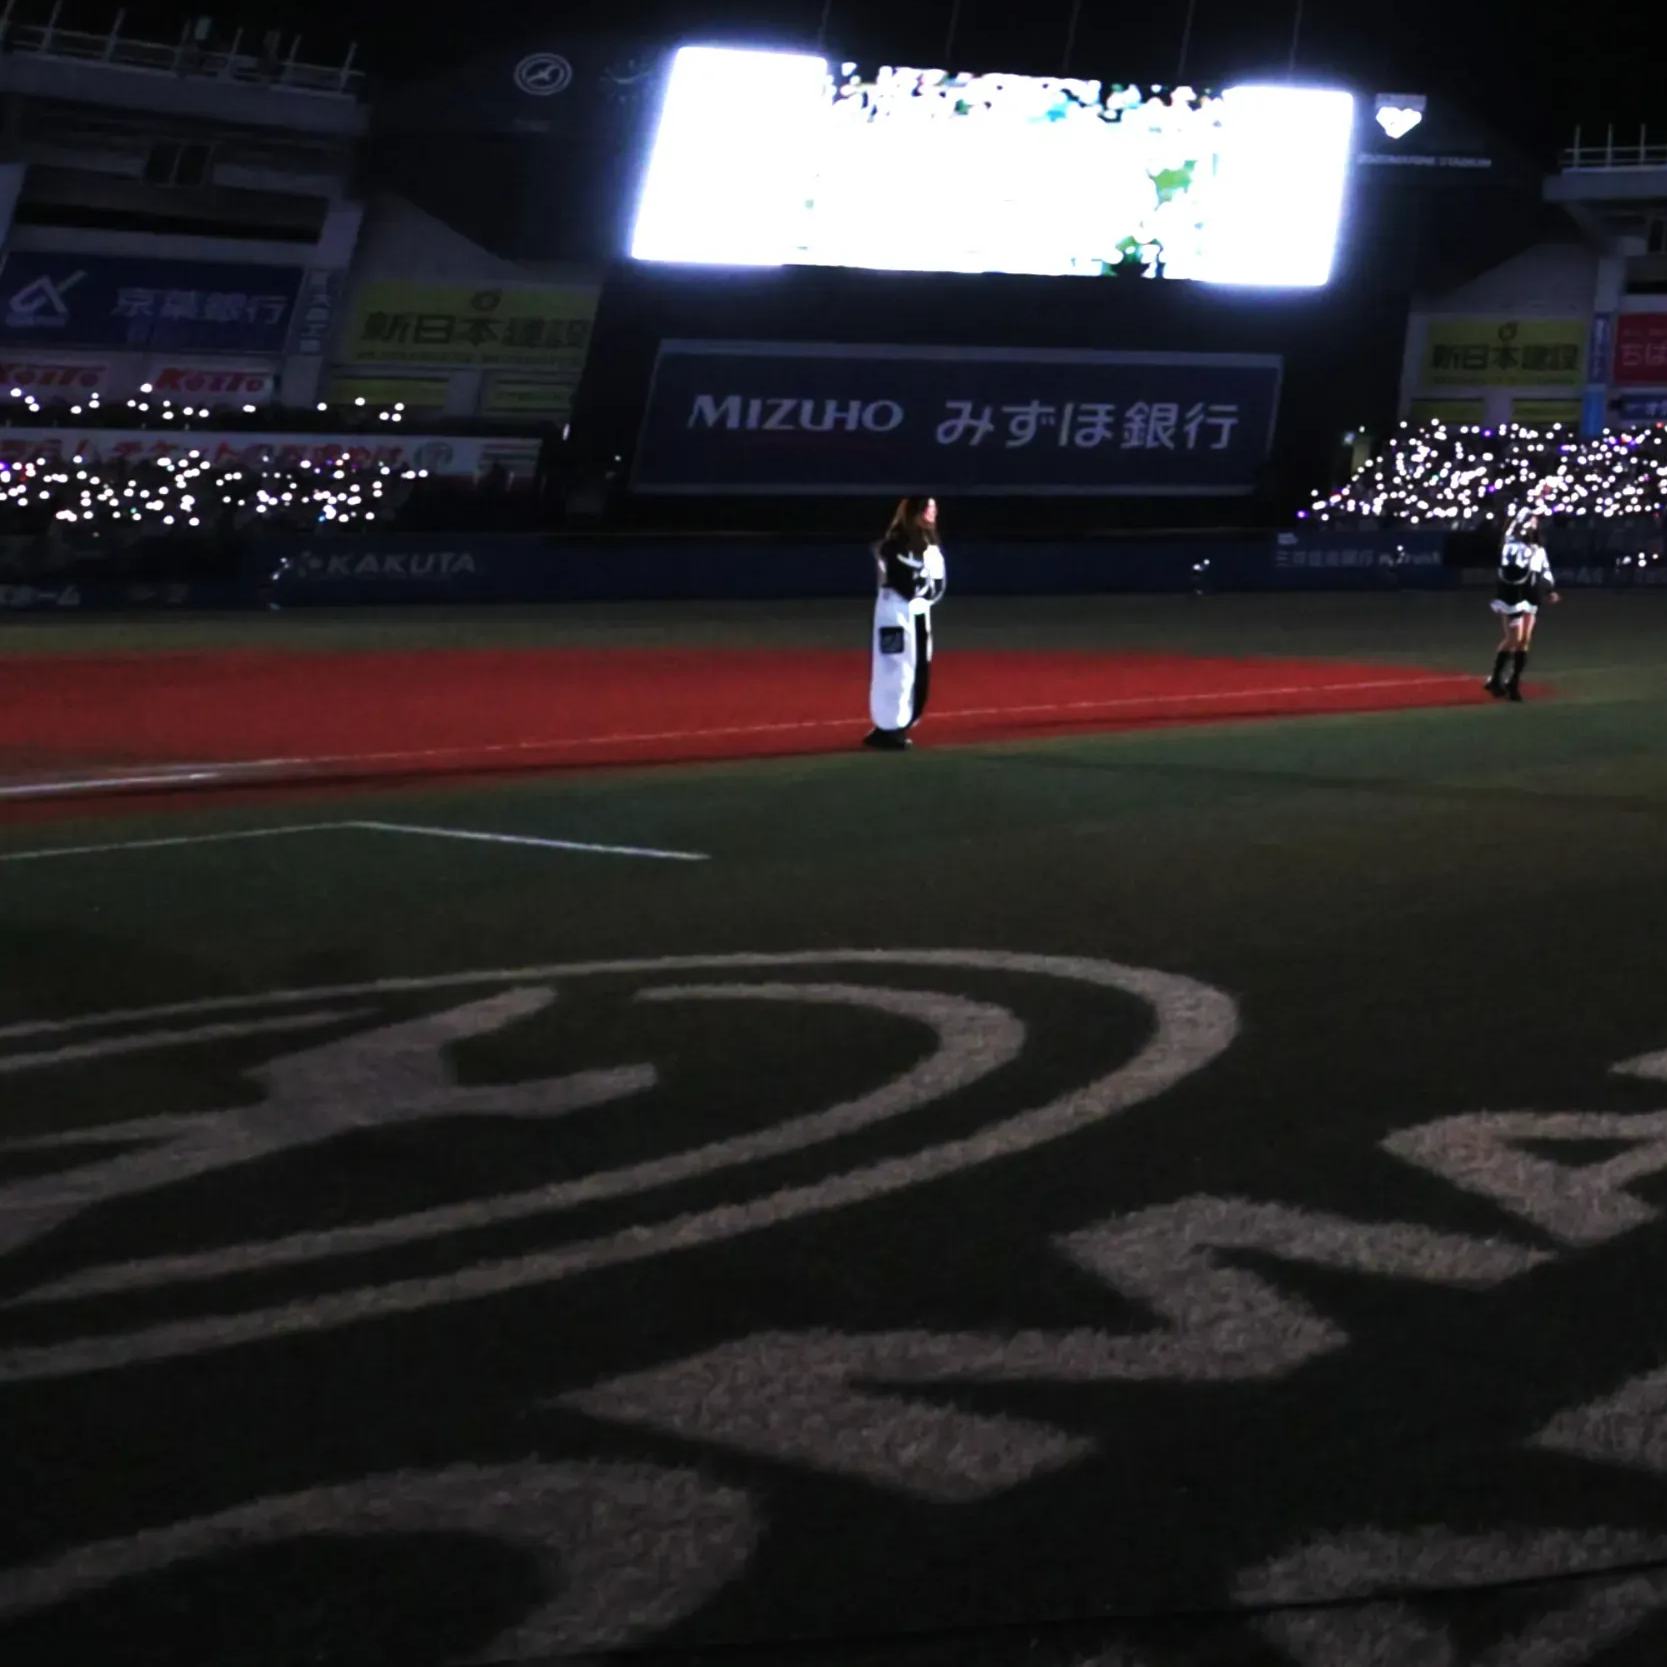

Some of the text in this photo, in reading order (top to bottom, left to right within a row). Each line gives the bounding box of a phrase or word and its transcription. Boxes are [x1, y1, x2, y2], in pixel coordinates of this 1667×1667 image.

[687, 393, 1240, 453] MIZUHO みずほ銀行
[325, 552, 477, 575] KAKUTA
